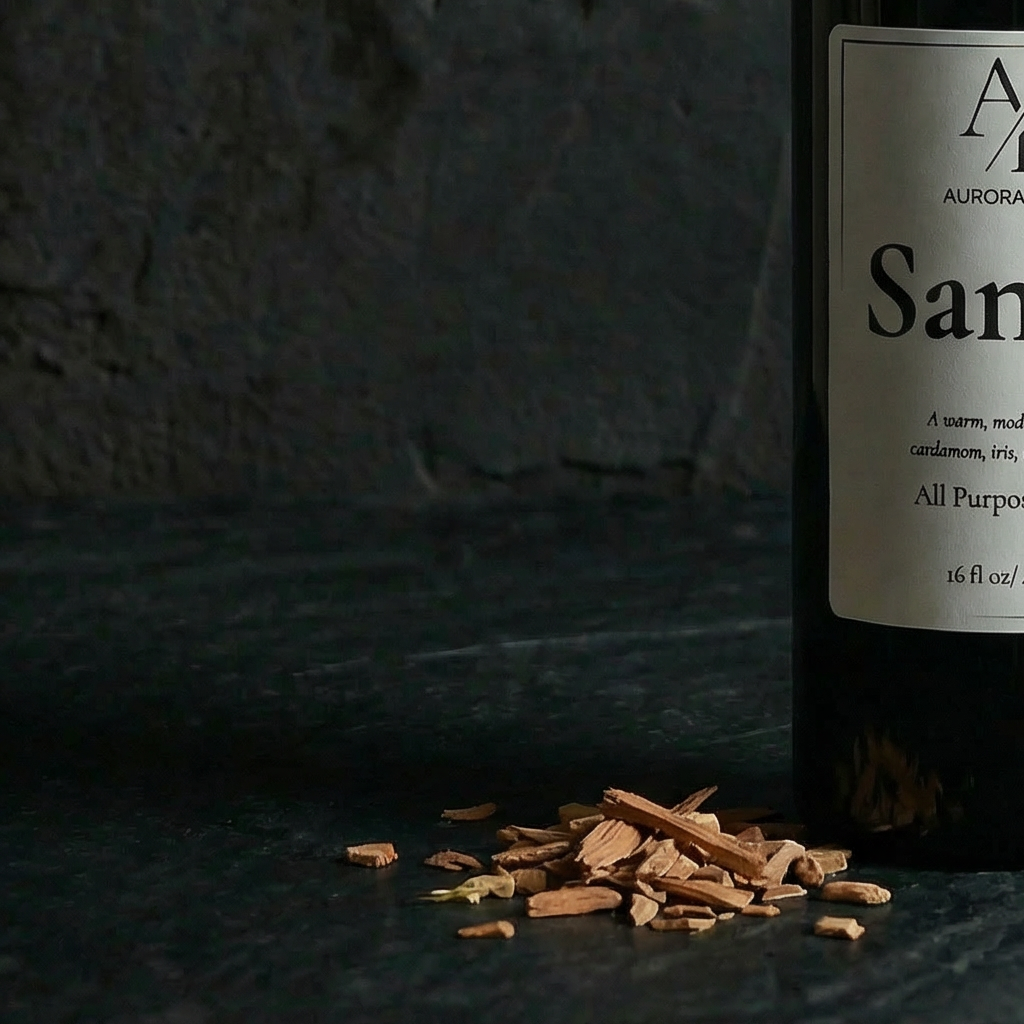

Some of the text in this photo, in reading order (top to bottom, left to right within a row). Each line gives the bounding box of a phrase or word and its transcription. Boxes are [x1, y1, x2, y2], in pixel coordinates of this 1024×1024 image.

[926, 411, 939, 427] A
[943, 416, 988, 431] warm,
[910, 440, 986, 462] cardamom,
[991, 444, 1018, 463] iris,
[914, 483, 946, 506] All
[946, 565, 965, 583] 16
[970, 564, 983, 584] fl
[988, 564, 1019, 588] oz/
